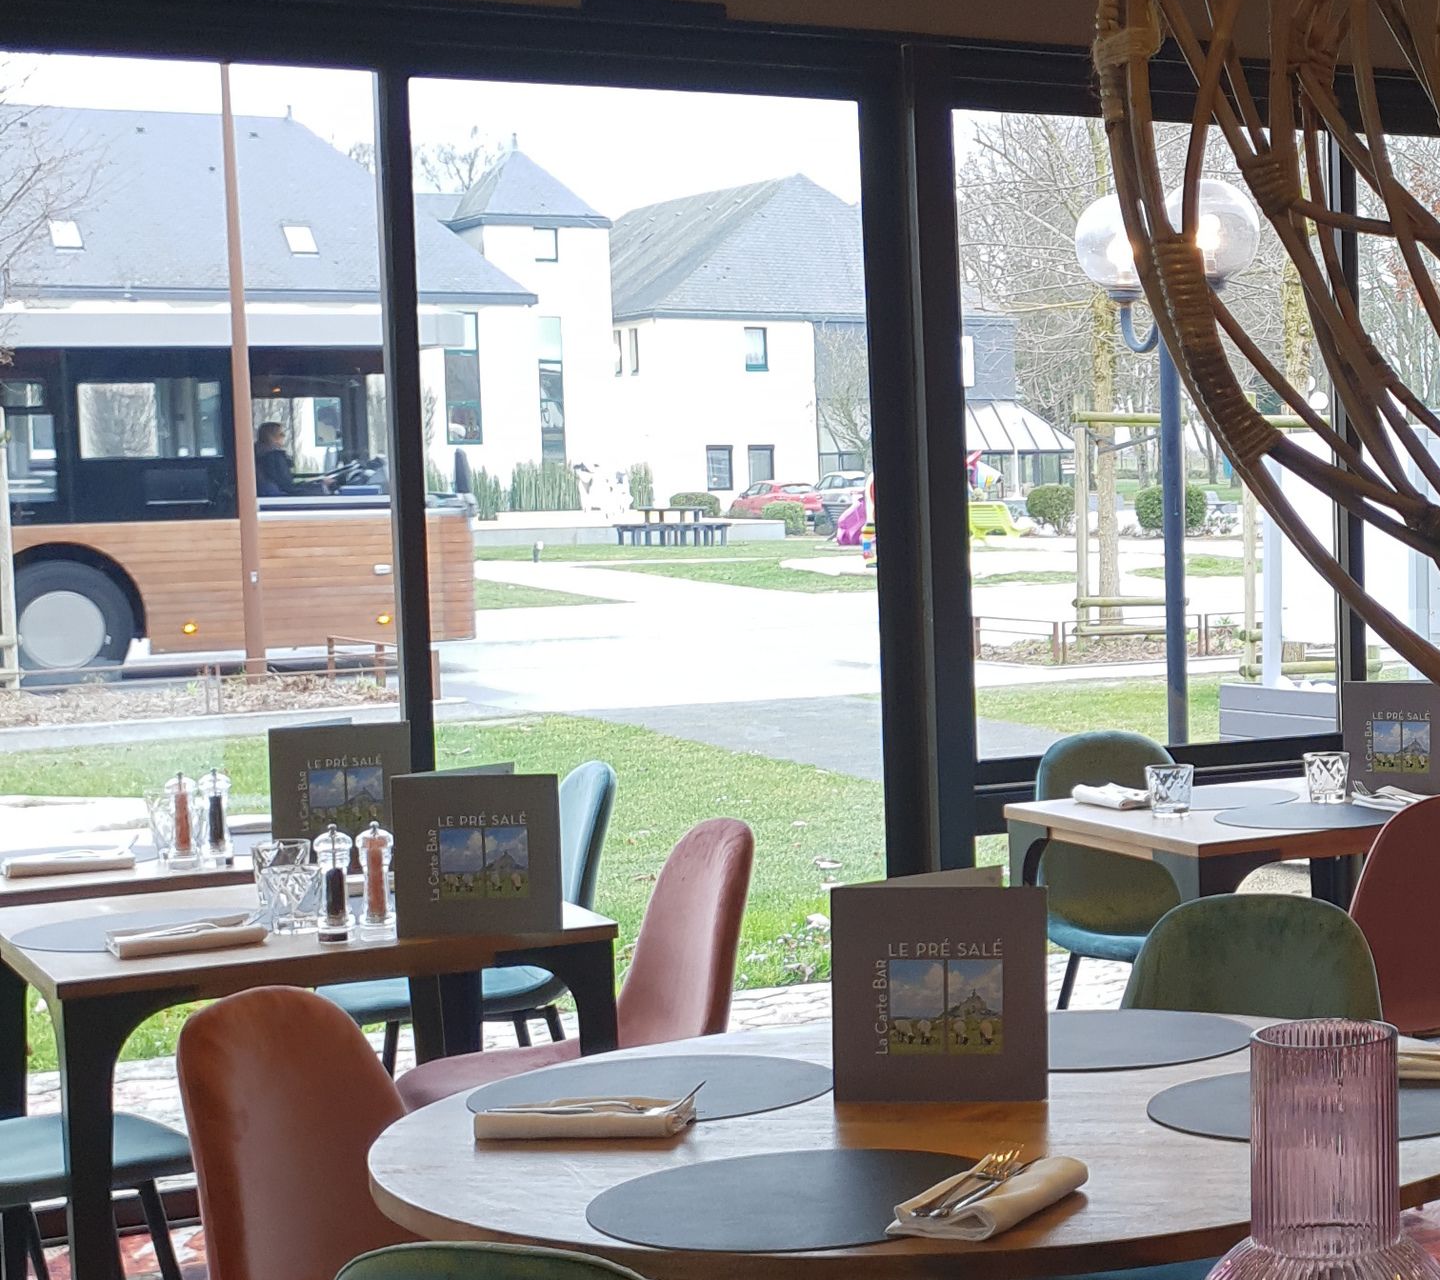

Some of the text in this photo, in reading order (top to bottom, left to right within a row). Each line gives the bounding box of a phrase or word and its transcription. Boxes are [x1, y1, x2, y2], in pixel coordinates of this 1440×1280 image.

[1372, 708, 1431, 721] LE PRÉ SALÉ
[307, 752, 383, 769] LE PRÉ SALÉ
[437, 810, 527, 827] LE PRÉ SALÉ
[426, 829, 440, 902] La Carte BAR
[888, 937, 1003, 957] LE PRÉ SALÉ
[872, 959, 889, 1056] La Carte BAR
